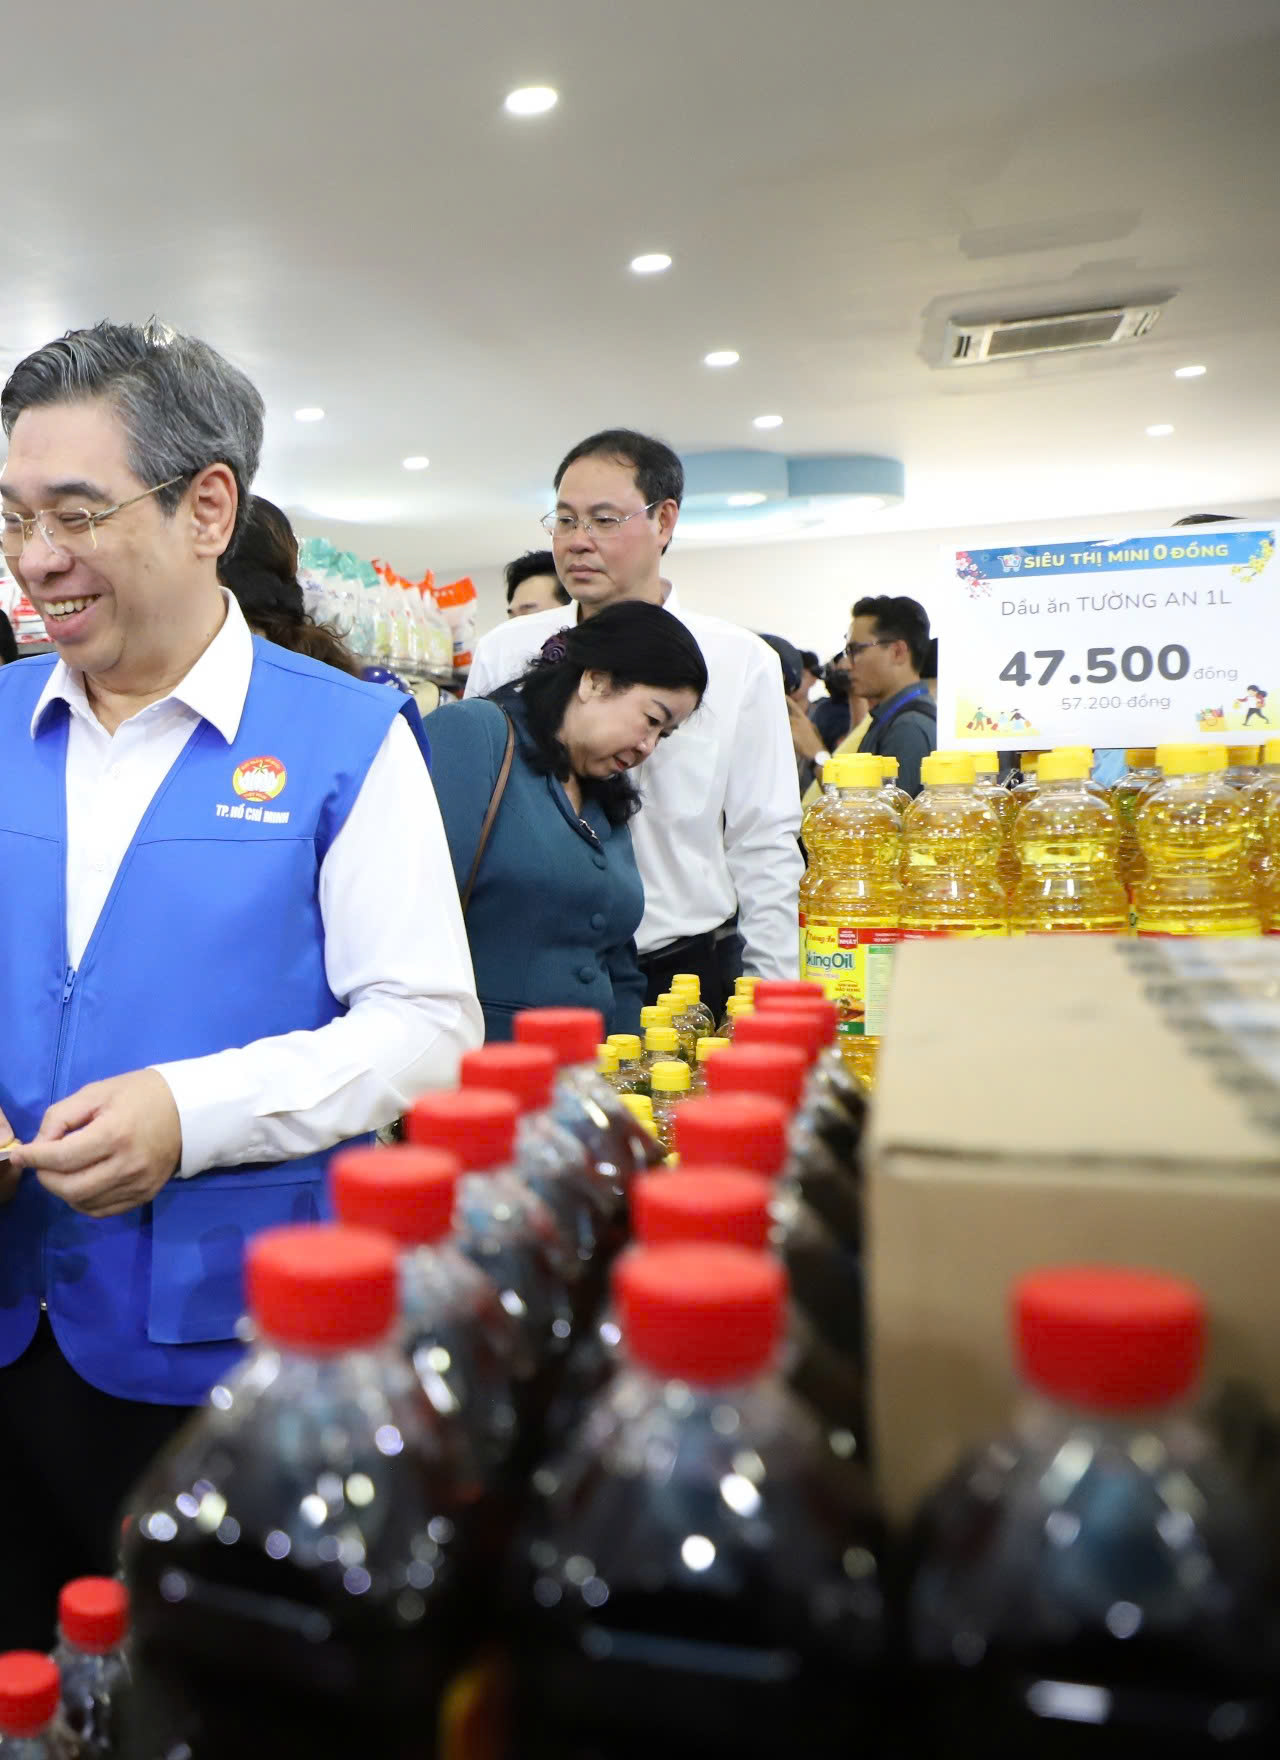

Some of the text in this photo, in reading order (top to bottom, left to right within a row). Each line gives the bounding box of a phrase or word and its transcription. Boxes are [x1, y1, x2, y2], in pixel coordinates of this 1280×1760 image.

[1023, 551, 1065, 569] SIÊU
[1070, 551, 1102, 567] THỊ
[1108, 549, 1150, 563] MINI
[1153, 544, 1168, 560] 0
[1047, 595, 1070, 613] ăn
[1076, 590, 1157, 612] TƯỜNG
[1165, 591, 1197, 607] AN
[1207, 590, 1232, 606] 1L
[999, 644, 1191, 687] 47.500
[1061, 696, 1121, 711] 57.200
[807, 951, 853, 970] kingOil
